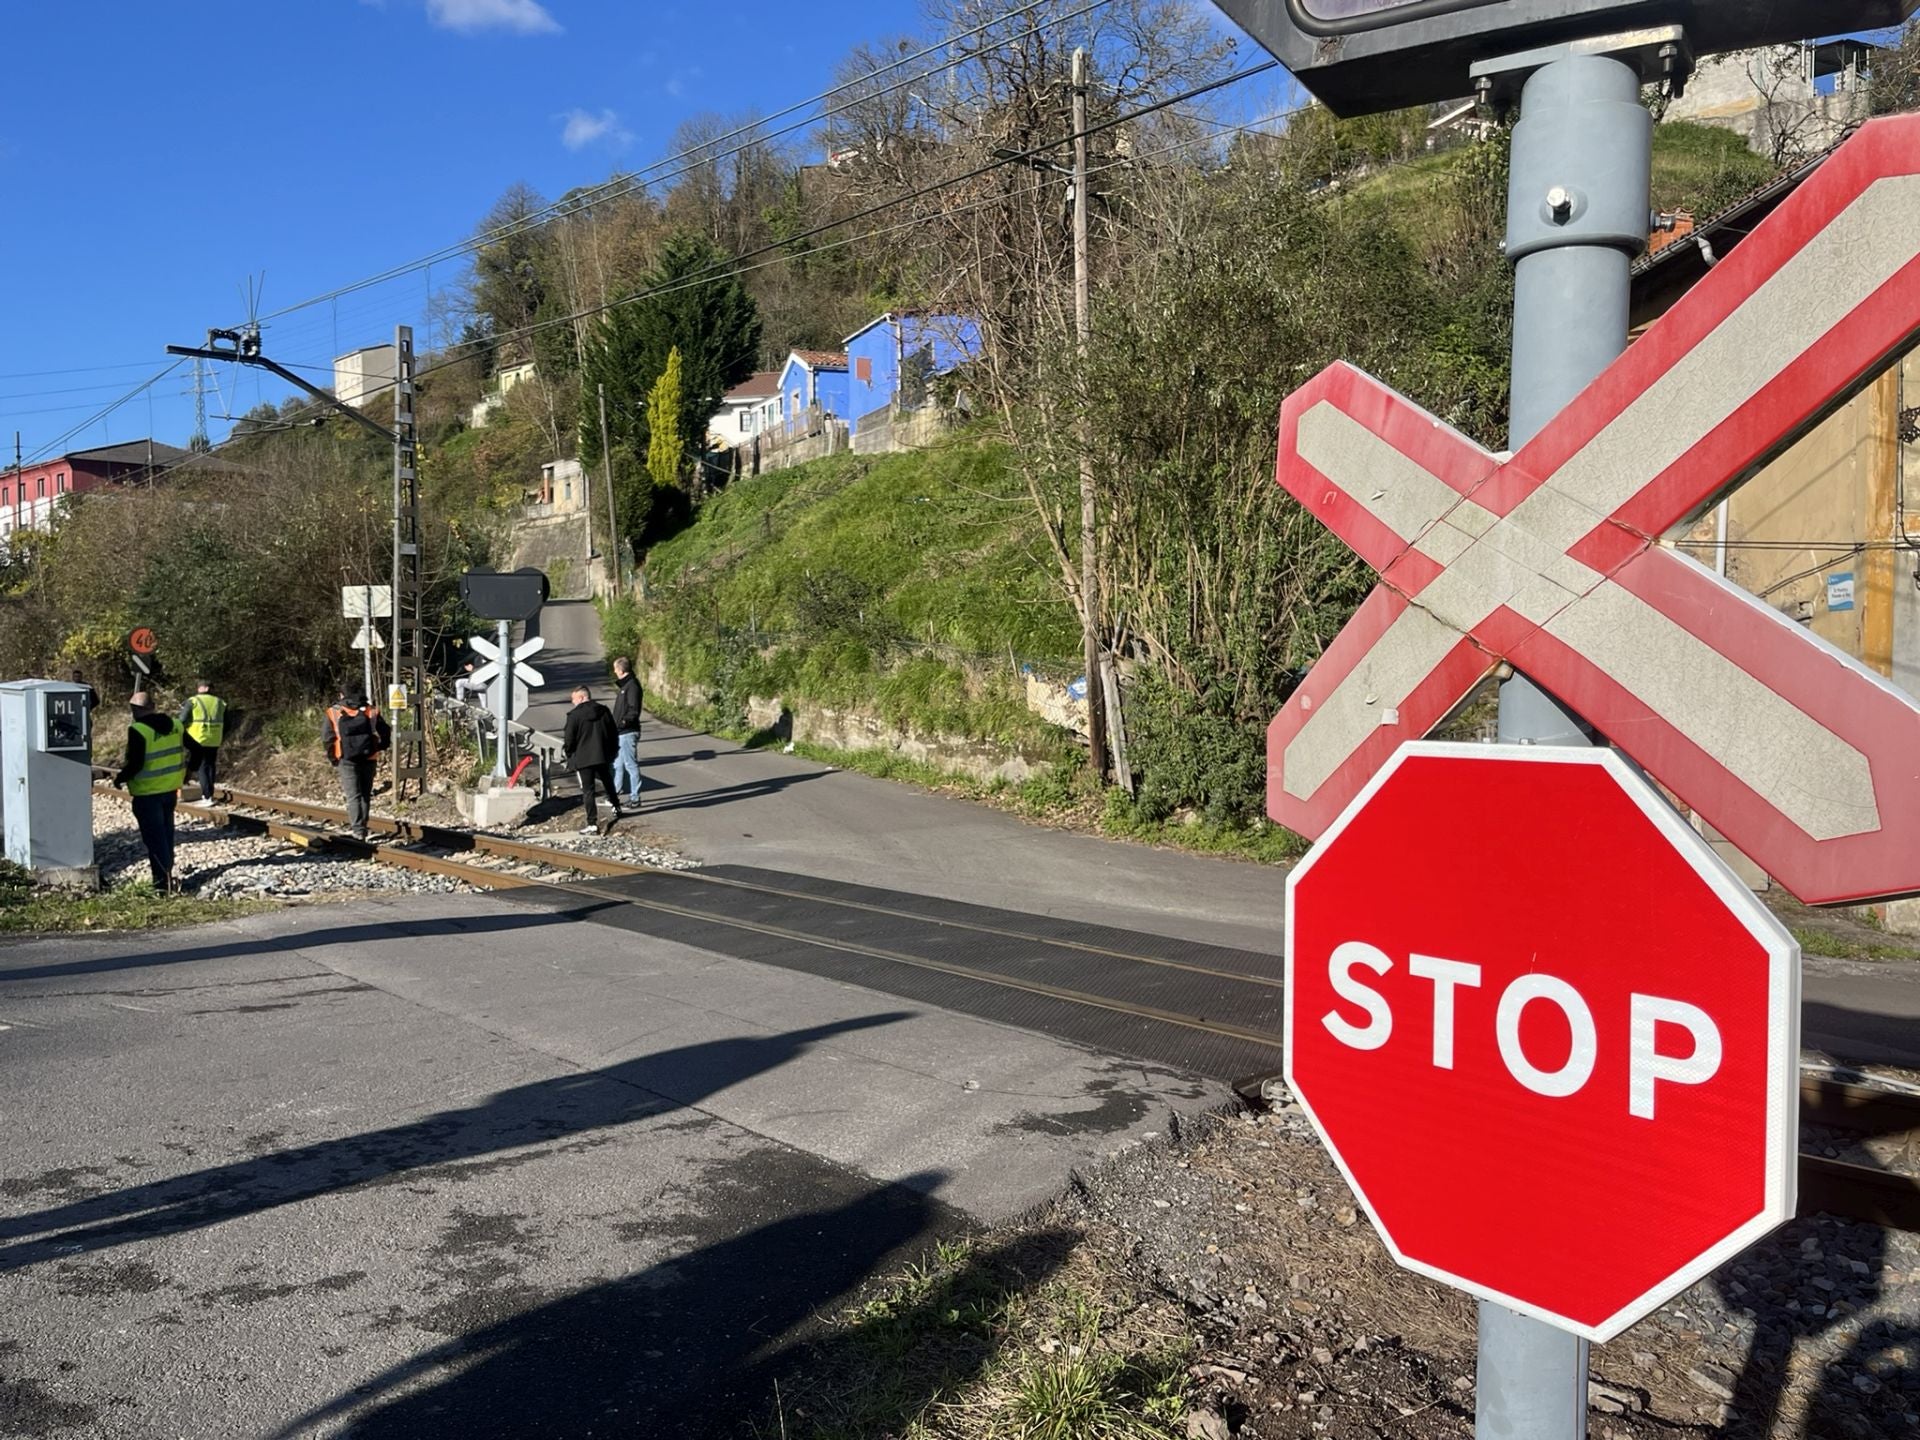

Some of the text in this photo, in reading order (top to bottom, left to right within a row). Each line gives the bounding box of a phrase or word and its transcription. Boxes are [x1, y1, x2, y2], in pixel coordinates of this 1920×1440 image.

[136, 633, 152, 648] 40
[54, 700, 75, 715] ML
[1321, 941, 1723, 1121] STOP
